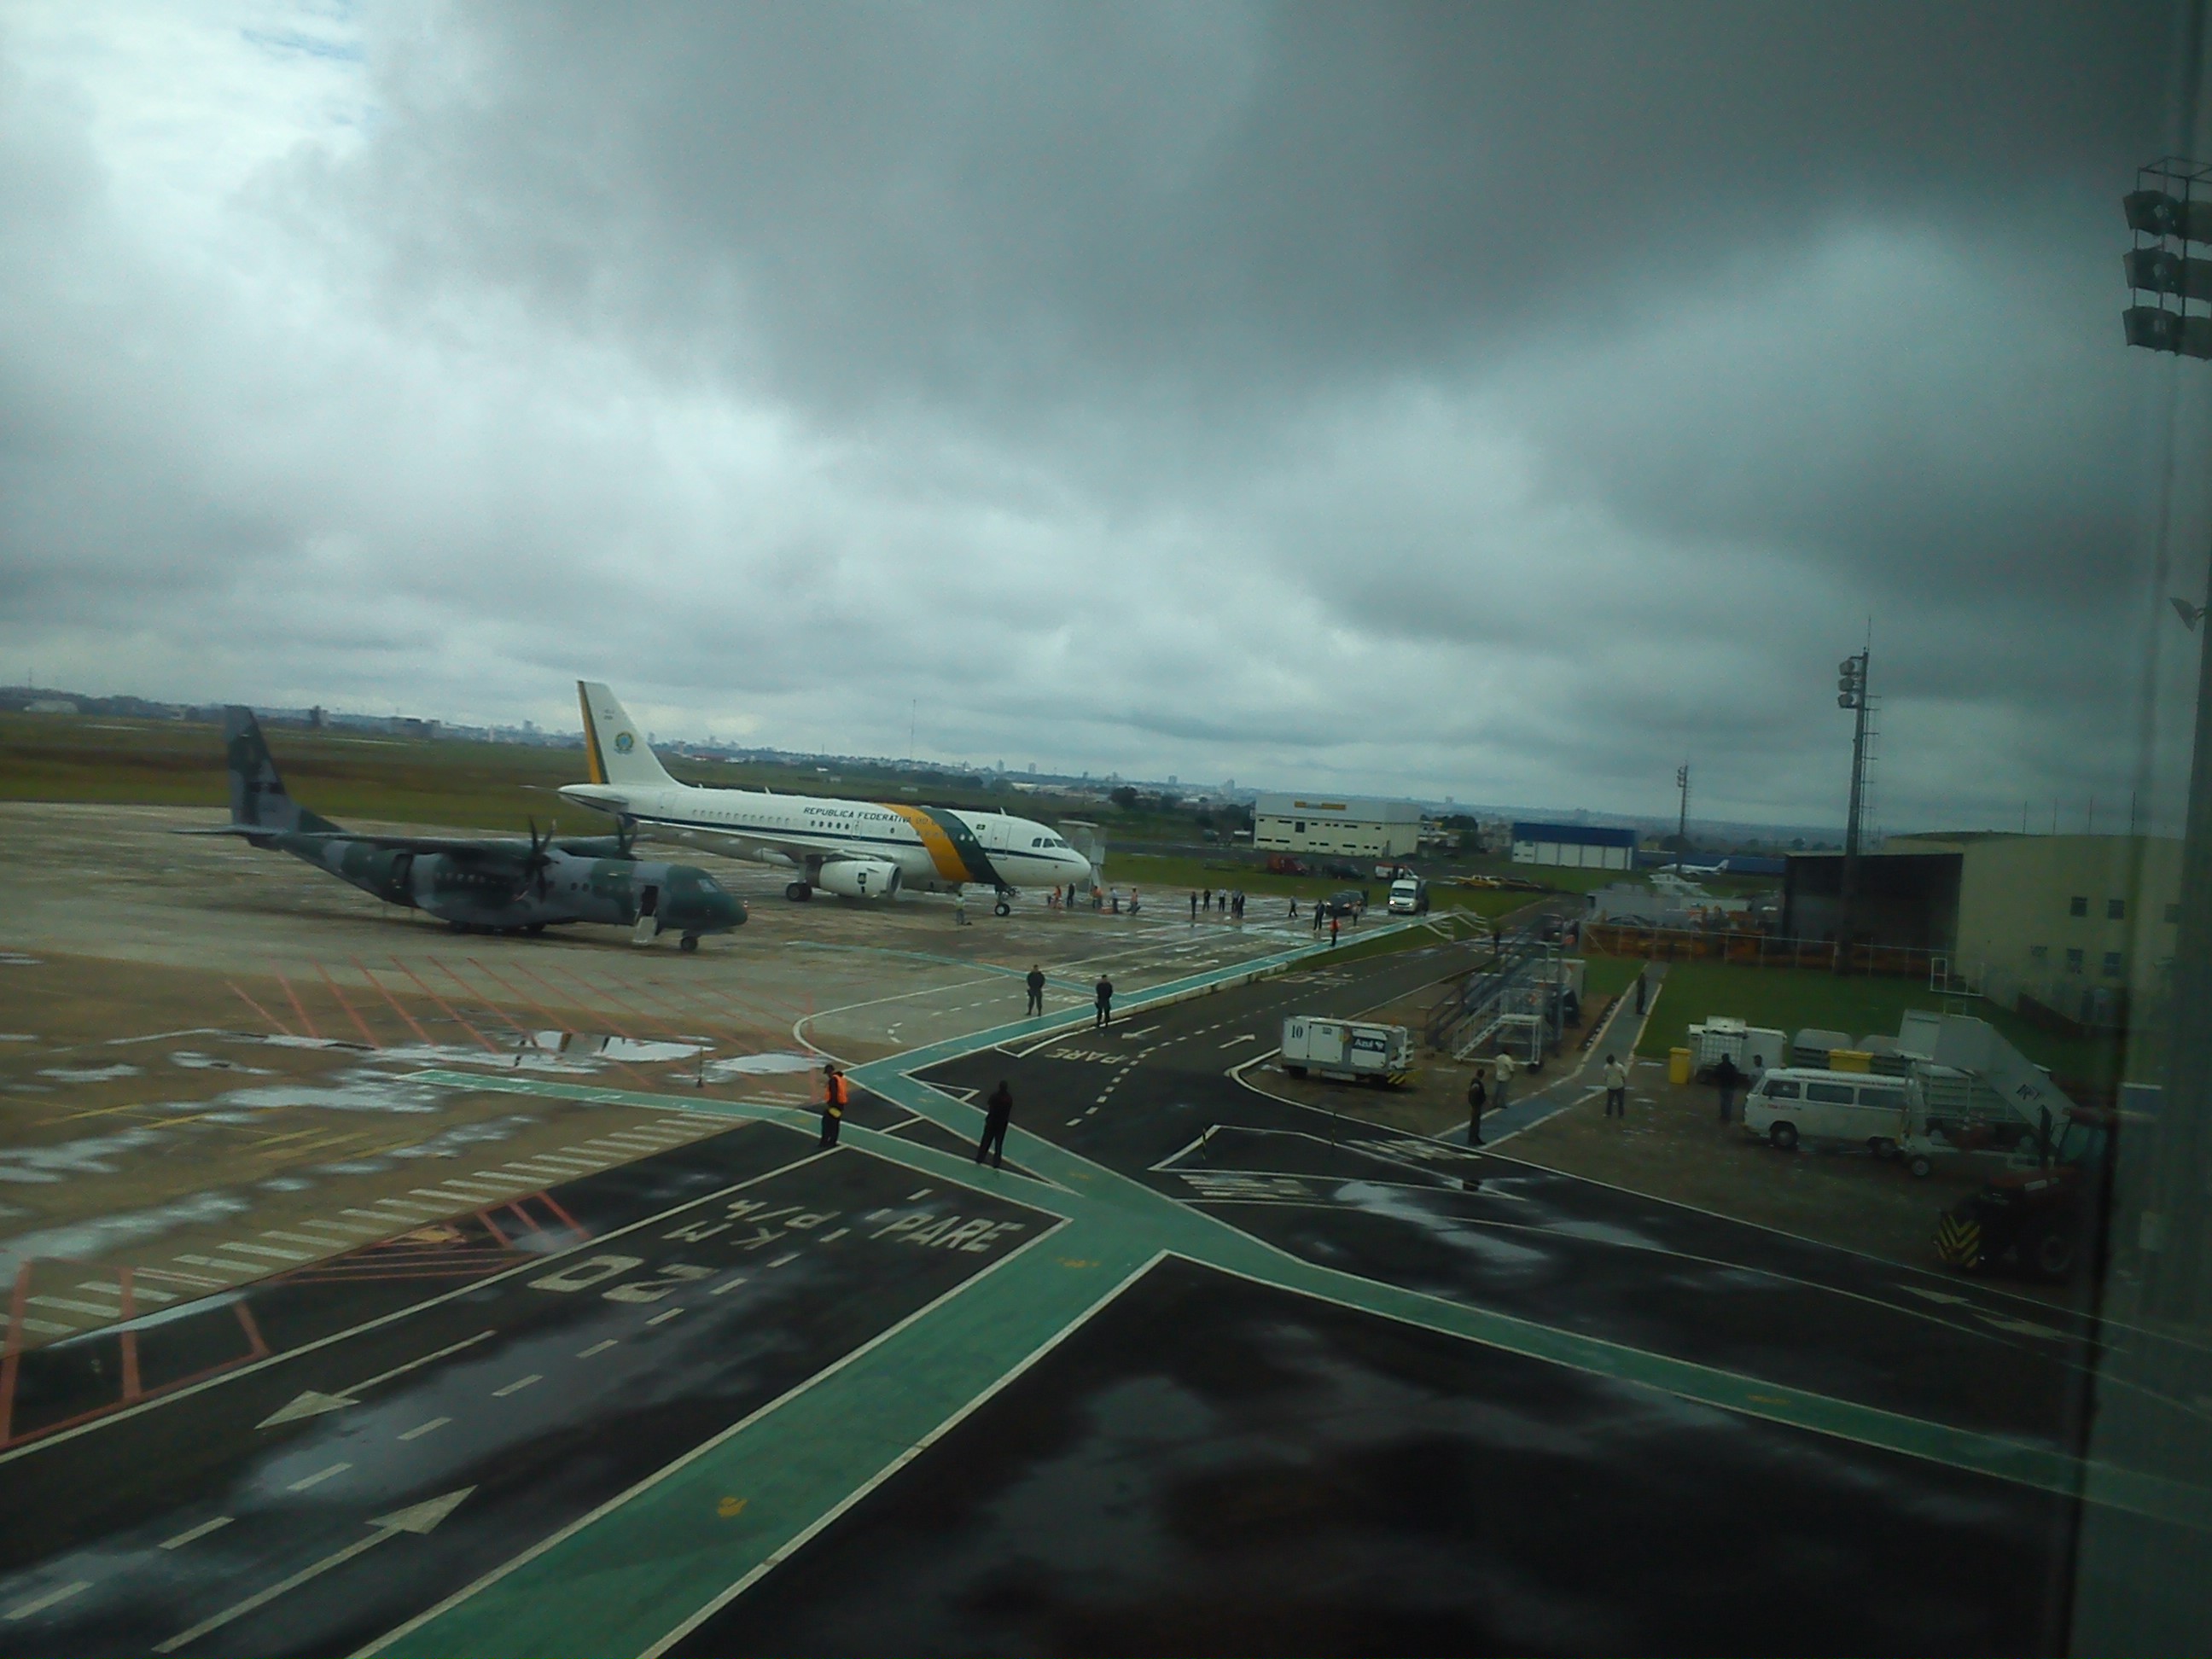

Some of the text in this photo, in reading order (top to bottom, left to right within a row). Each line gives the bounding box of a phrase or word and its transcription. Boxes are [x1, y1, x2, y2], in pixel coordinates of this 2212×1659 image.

[1290, 1025, 1303, 1039] 10
[1353, 1039, 1375, 1048] Azul
[869, 1213, 1025, 1253] PARE
